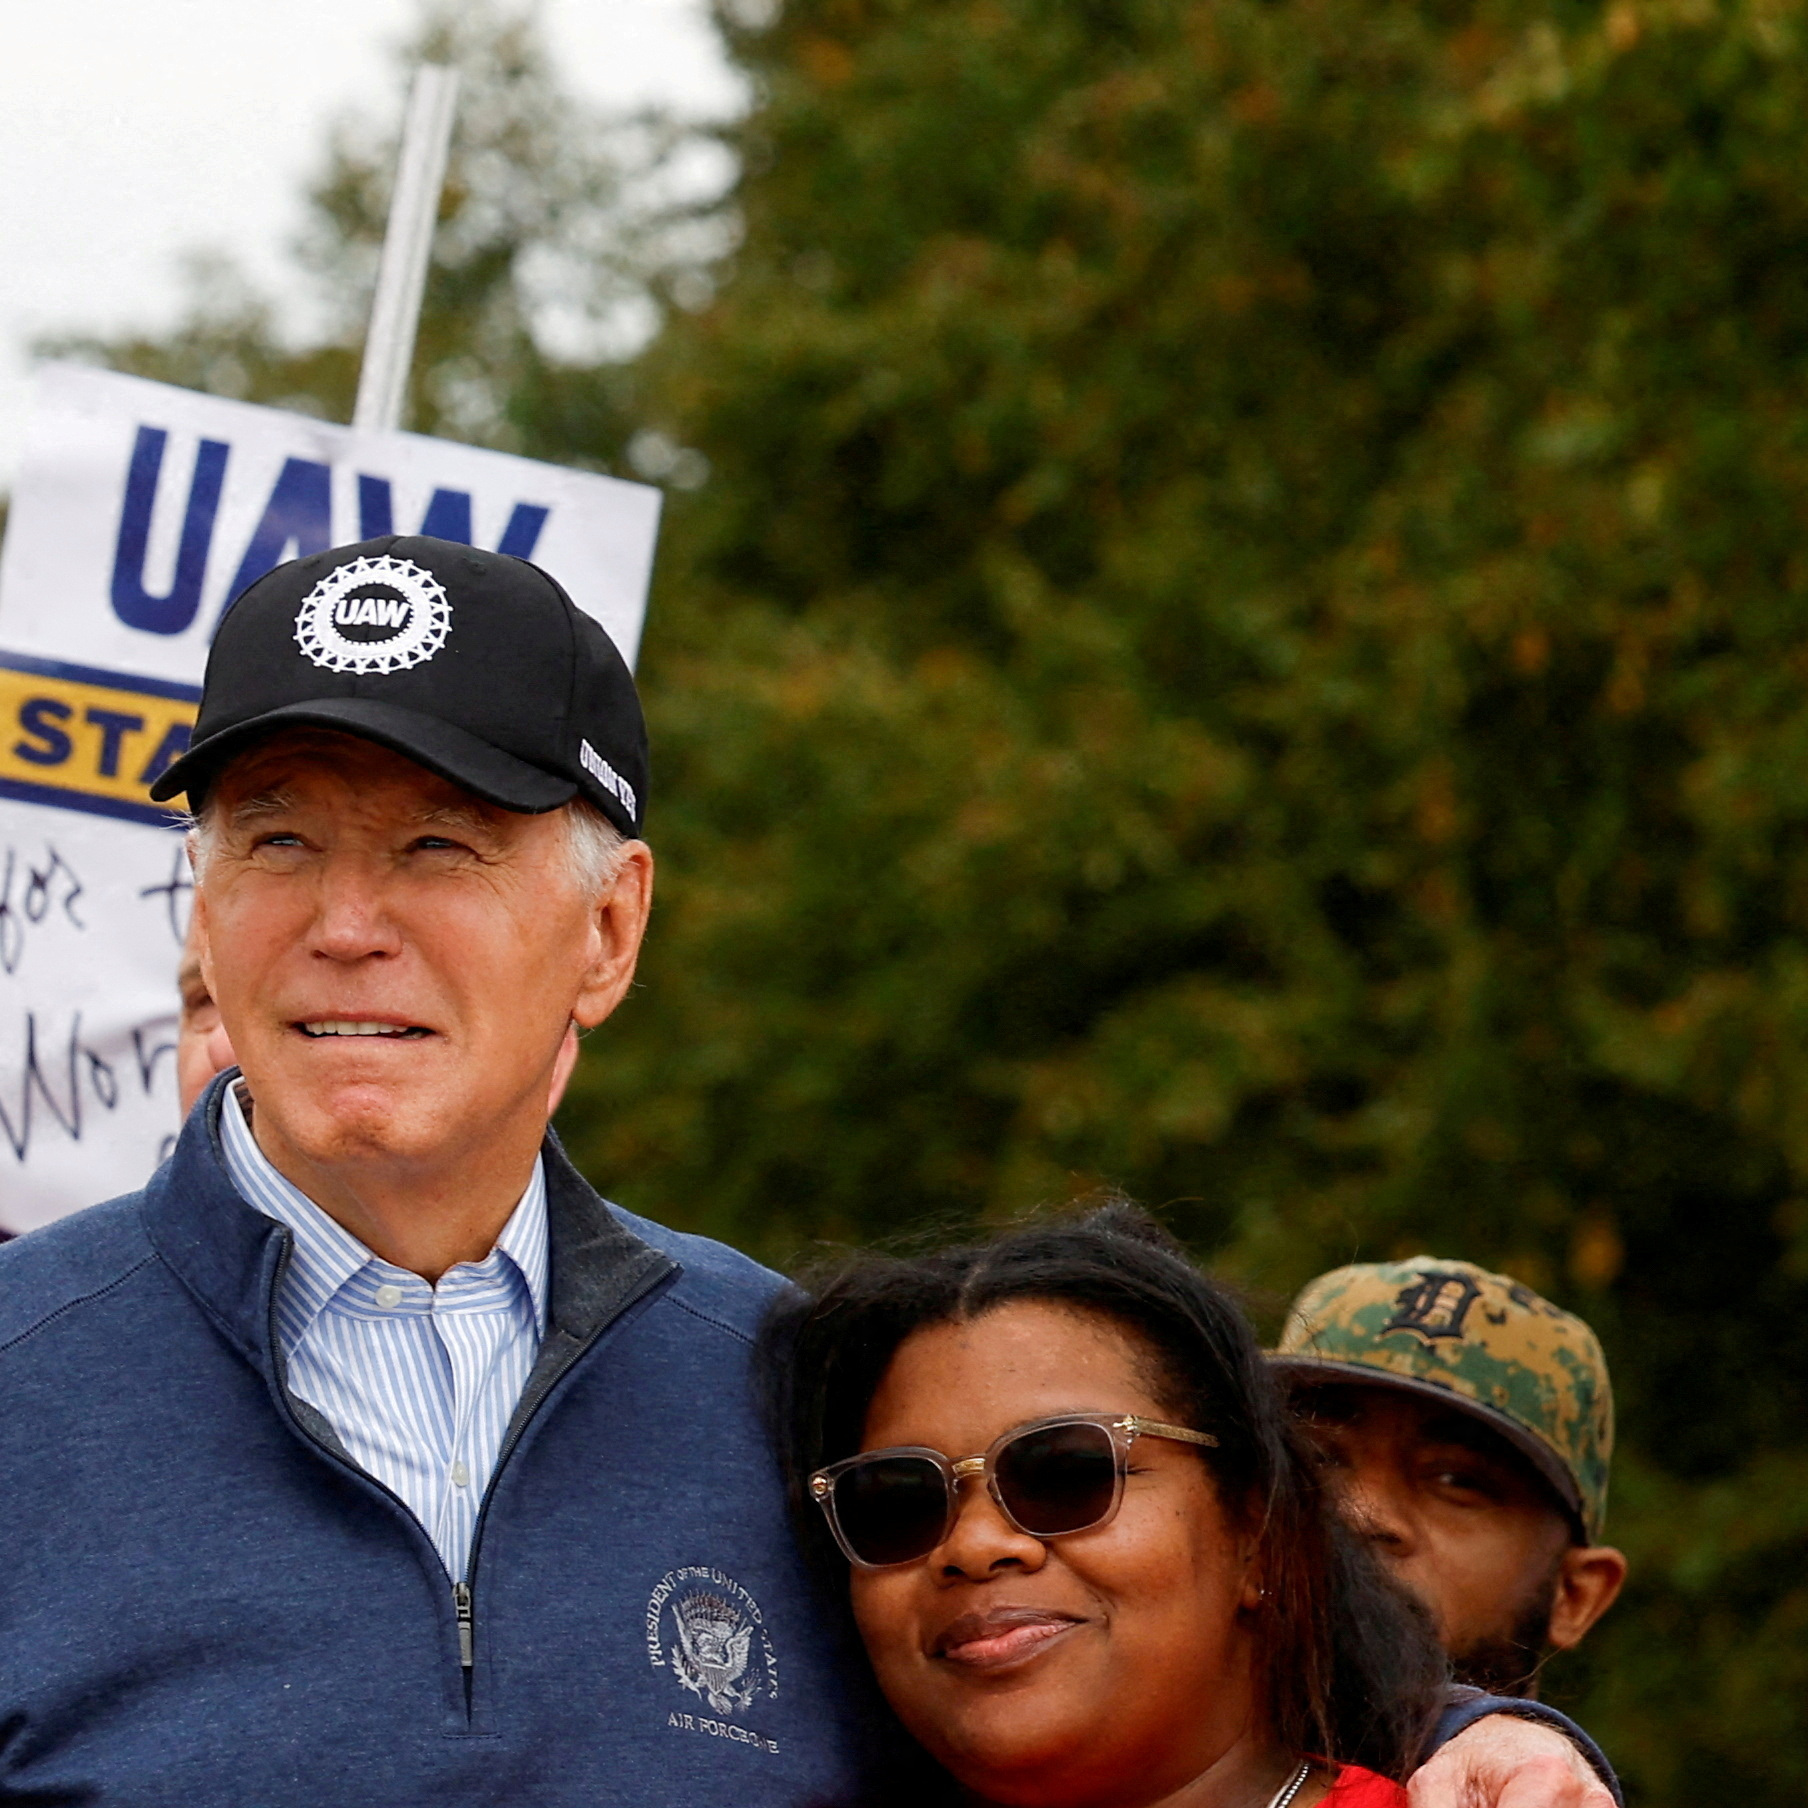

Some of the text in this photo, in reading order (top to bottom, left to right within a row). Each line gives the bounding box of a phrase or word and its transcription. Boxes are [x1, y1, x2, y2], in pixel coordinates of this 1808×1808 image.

[335, 598, 410, 628] UAW
[647, 1571, 677, 1667] PRESIDENT
[688, 1566, 710, 1578] THE
[711, 1568, 763, 1624] UNITED
[667, 1711, 695, 1731] AIR
[698, 1717, 749, 1744] FORCE
